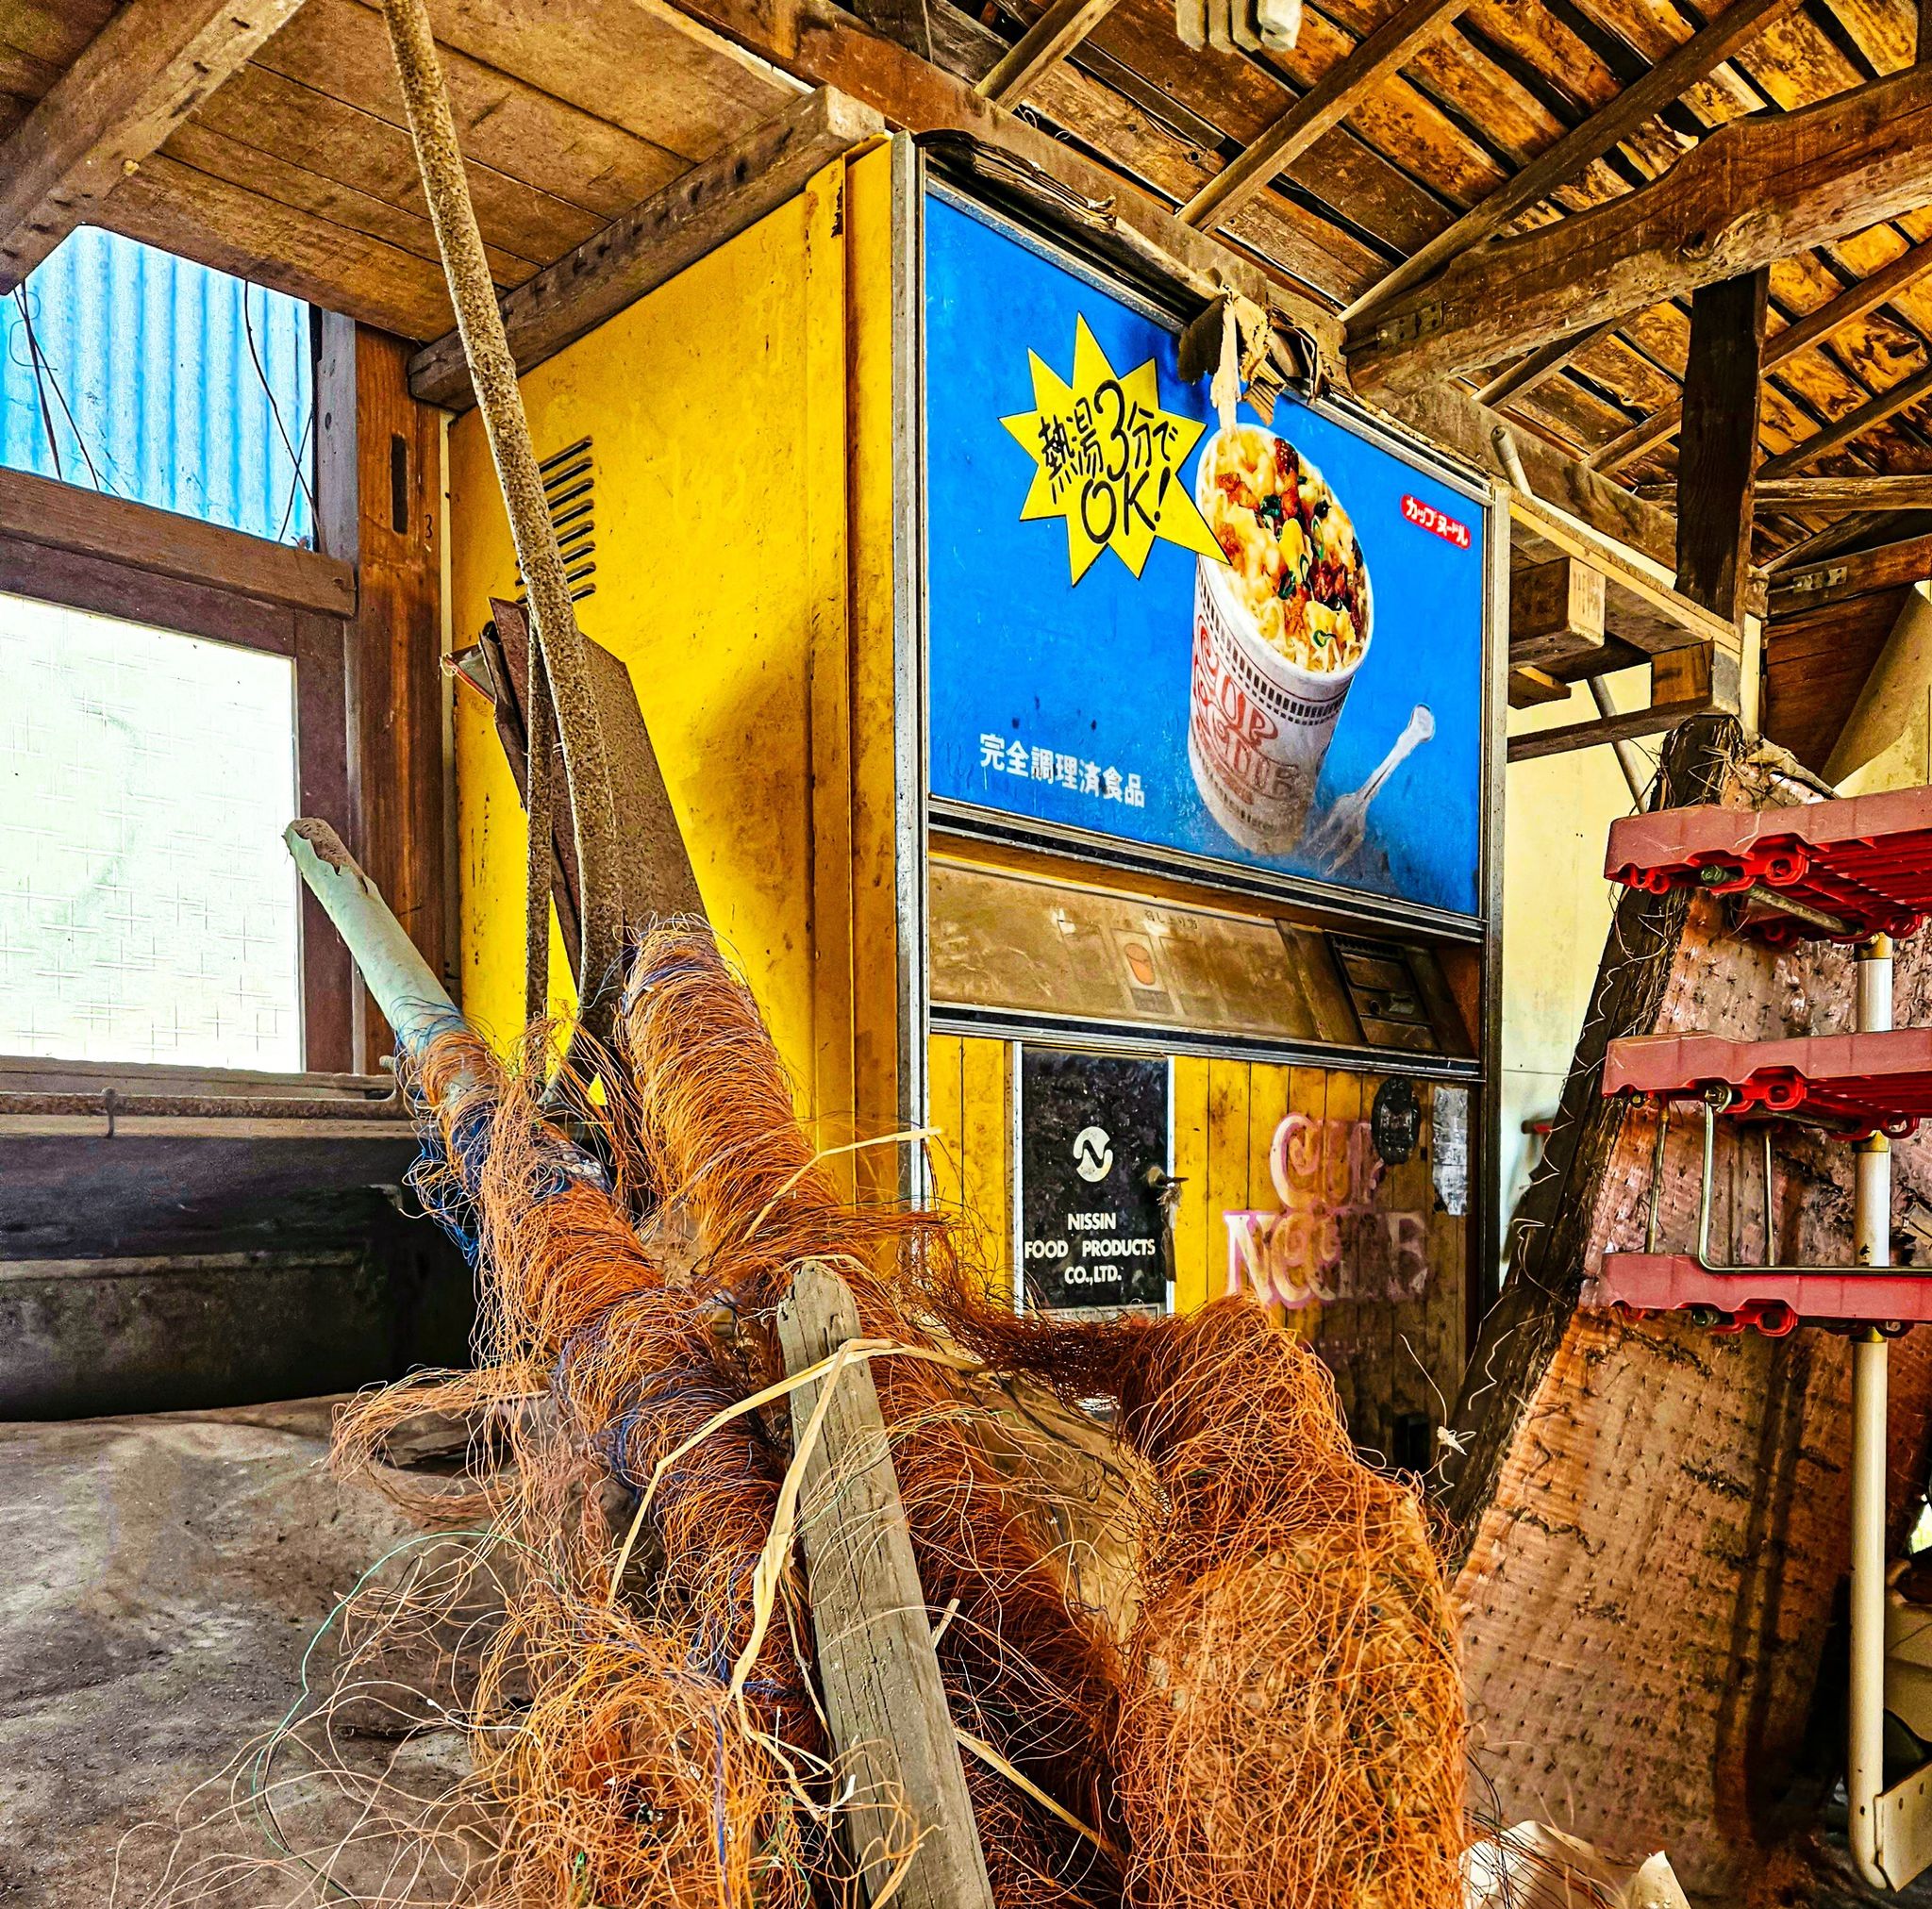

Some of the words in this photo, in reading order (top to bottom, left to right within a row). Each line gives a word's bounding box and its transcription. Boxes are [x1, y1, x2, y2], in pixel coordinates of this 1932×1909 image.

[1039, 379, 1178, 505] 熱湯3分で
[1081, 467, 1171, 544] OK!
[980, 733, 1145, 808] 完全調理済食品
[1024, 1239, 1069, 1259] FOOD
[1081, 1237, 1156, 1258] PRODUCTS
[1067, 1212, 1117, 1231] NISSIN
